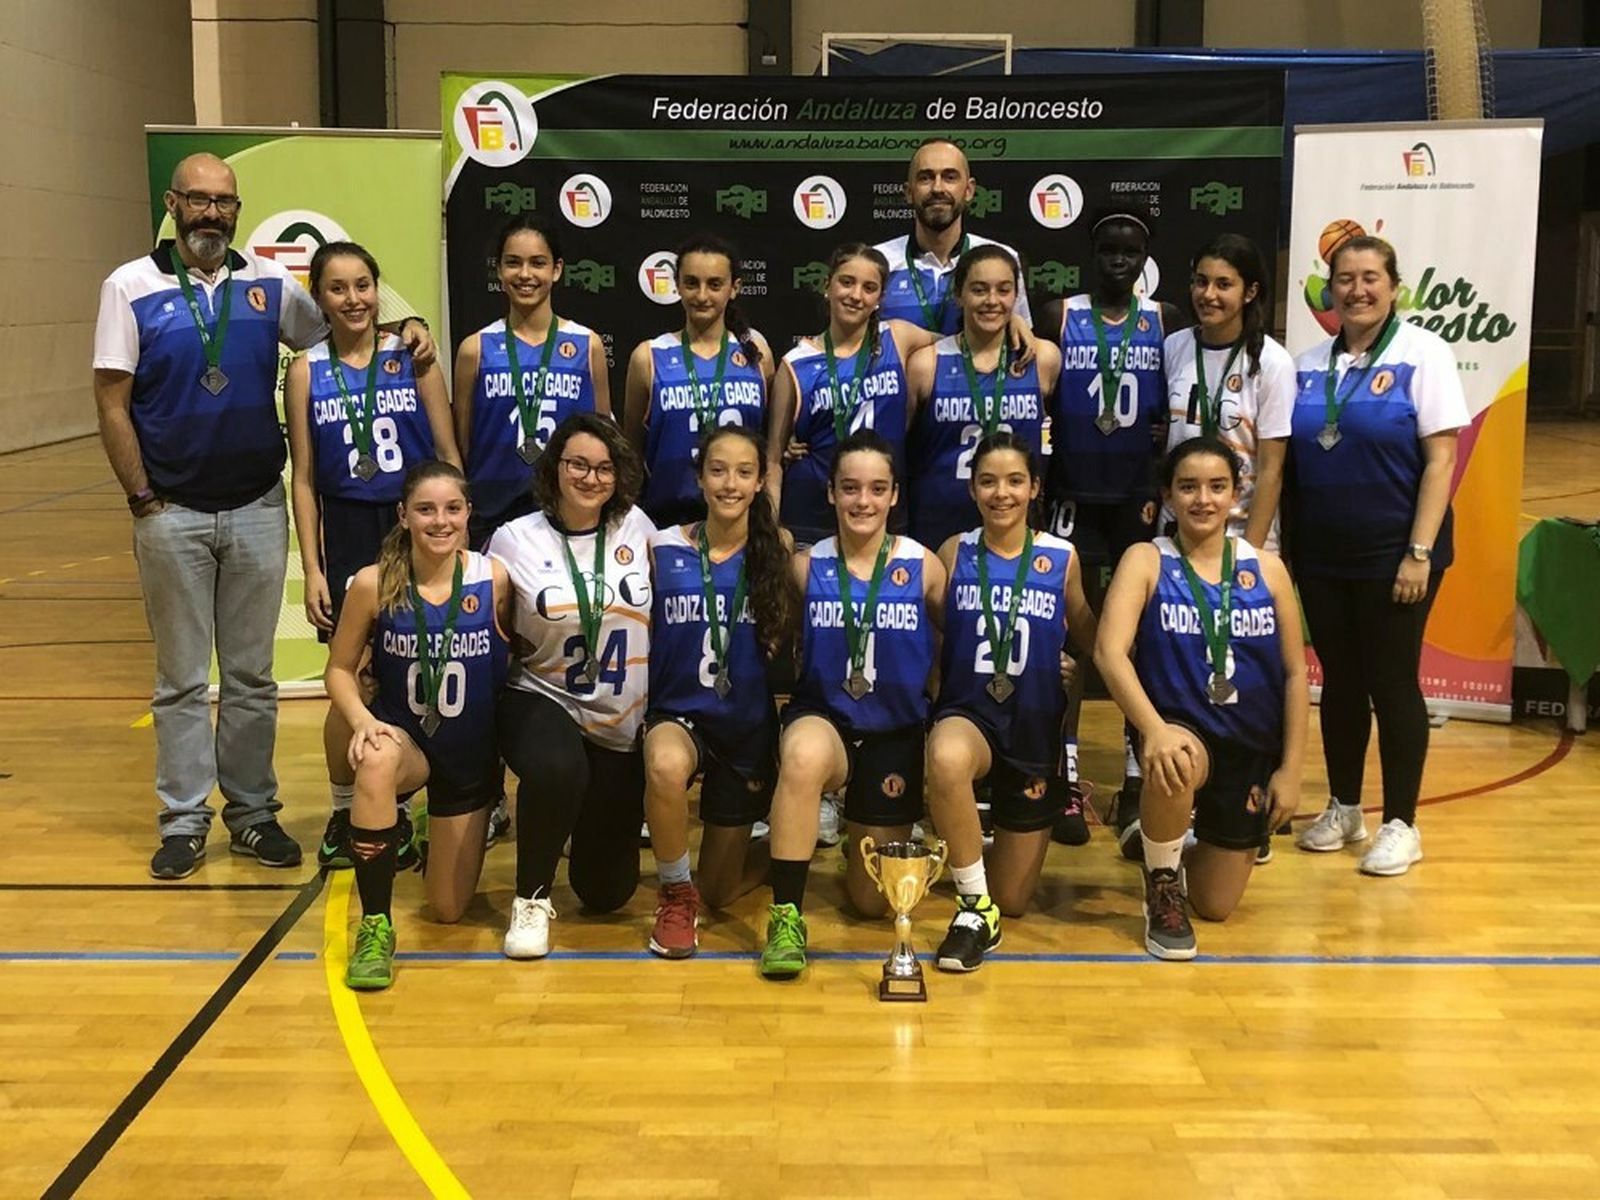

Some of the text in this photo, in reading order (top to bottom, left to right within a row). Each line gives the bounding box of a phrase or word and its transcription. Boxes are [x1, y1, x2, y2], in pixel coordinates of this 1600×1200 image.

[651, 96, 1103, 121] Federación Andaluza de Baloncesto
[729, 134, 1007, 157] www.andaluzabalonco.org
[640, 183, 689, 193] FEDERACION
[678, 196, 688, 206] DE
[872, 183, 904, 194] FEDERA
[1110, 182, 1160, 192] FEDERACION
[640, 208, 690, 219] BALONCESTO
[1397, 267, 1477, 311] alor
[1065, 346, 1099, 370] CADIZ
[1124, 346, 1161, 370] GADES
[485, 372, 516, 398] CADI
[545, 372, 582, 400] GADES
[863, 371, 899, 399] GADES
[1087, 372, 1138, 428] 10
[376, 388, 417, 413] GADES
[934, 397, 972, 423] CADIZ
[999, 394, 1038, 420] GADES
[508, 399, 557, 451] 15
[1049, 499, 1077, 537] 10
[664, 594, 701, 625] CADIZ
[809, 601, 846, 628] CADIZ
[876, 602, 919, 632] GADES
[1018, 588, 1056, 620] GADES
[1230, 606, 1275, 638] GADES
[383, 629, 419, 659] CADIZ
[450, 628, 490, 659] GADES
[974, 615, 1030, 677] 20
[563, 628, 628, 697] 24
[407, 661, 467, 718] 00
